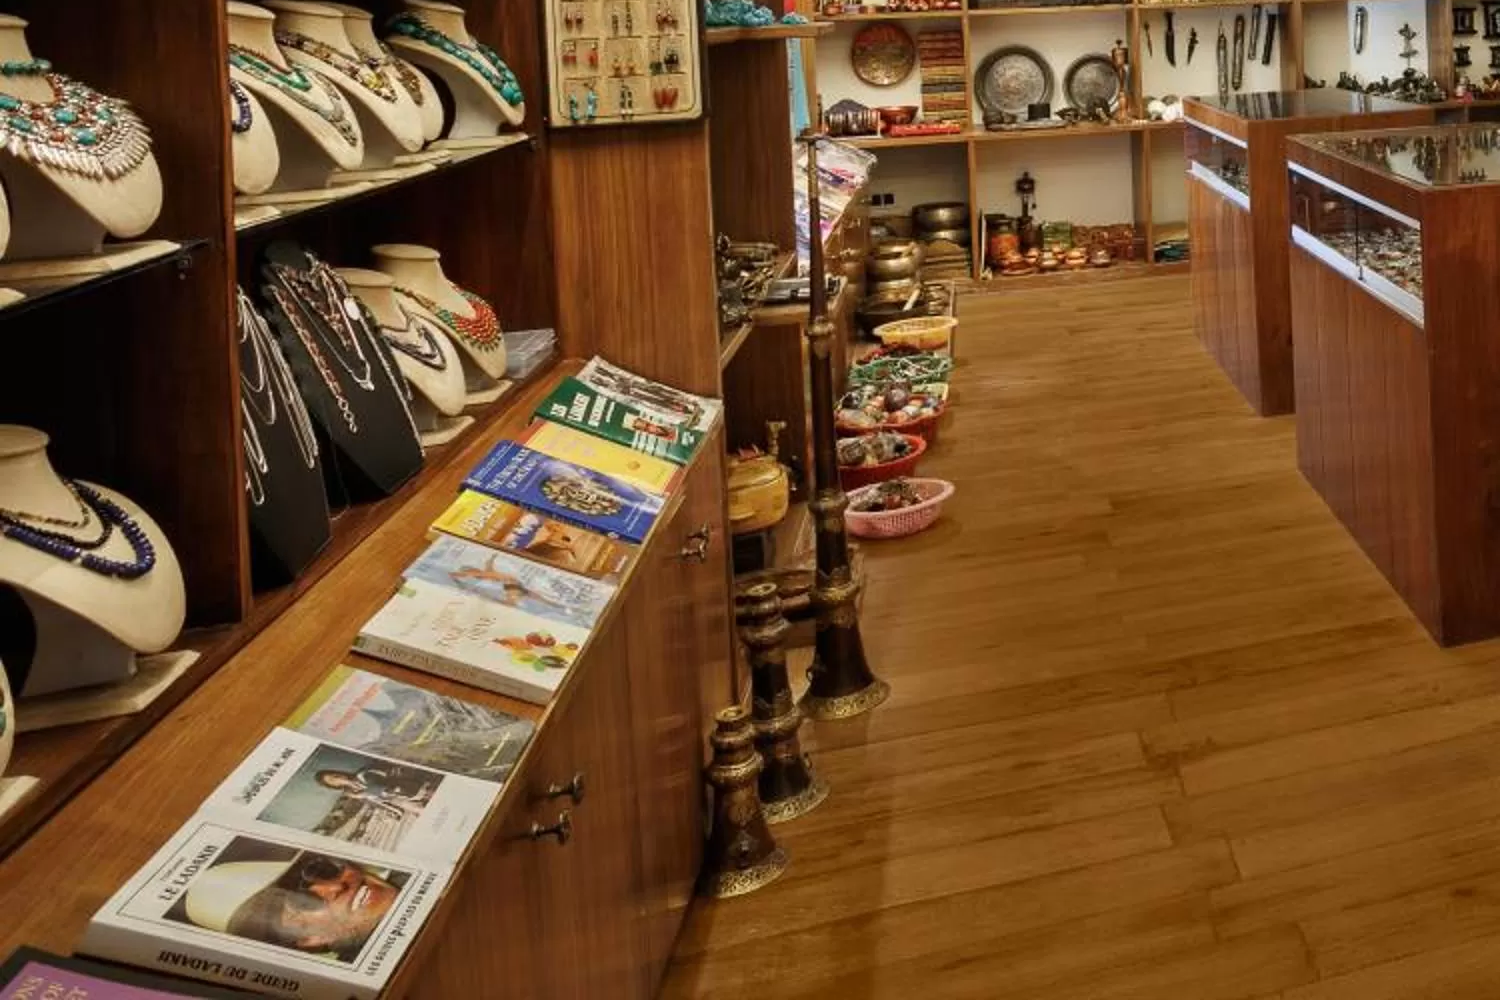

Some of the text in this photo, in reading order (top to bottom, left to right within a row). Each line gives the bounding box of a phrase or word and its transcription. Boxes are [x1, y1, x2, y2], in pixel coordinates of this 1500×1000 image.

[157, 951, 300, 992] GUIDE DU LADAKH
